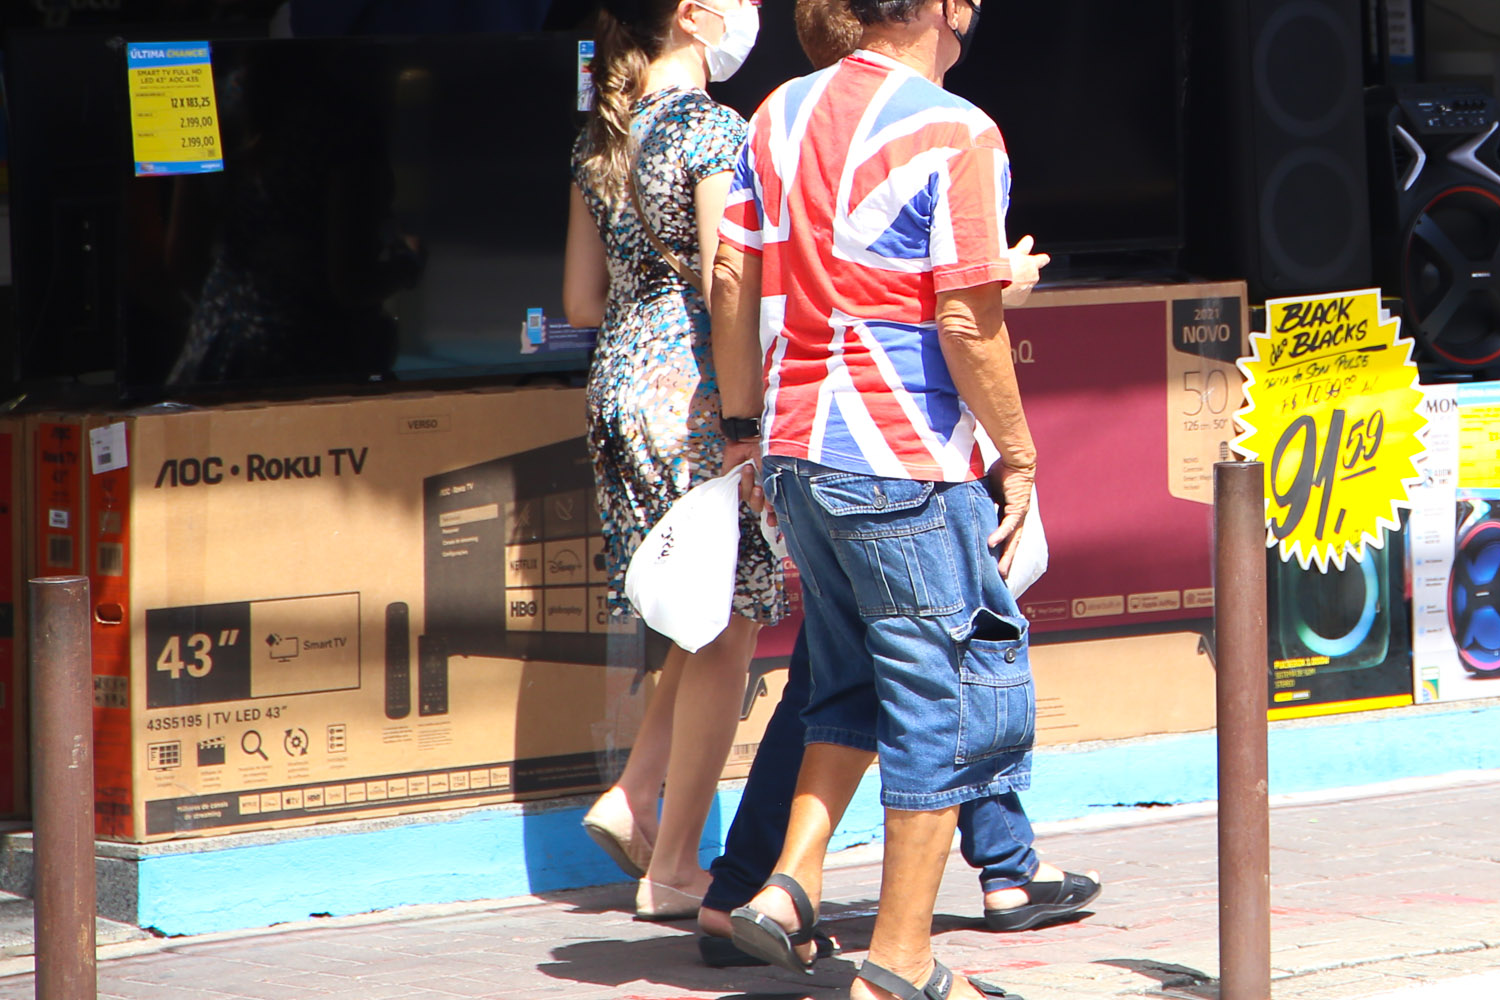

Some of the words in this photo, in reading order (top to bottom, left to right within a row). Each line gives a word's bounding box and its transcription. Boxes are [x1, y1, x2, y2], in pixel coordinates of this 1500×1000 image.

[130, 48, 165, 60] ÚLTIMA
[136, 69, 161, 77] SMART
[172, 68, 190, 76] FULL
[170, 98, 179, 109] 12
[180, 116, 213, 129] 2.199,00
[181, 135, 215, 148] 2.199,00
[1194, 307, 1220, 320] 2021
[1275, 297, 1355, 333] BLACK
[1183, 324, 1231, 345] NOVO
[1288, 319, 1368, 358] BLACKS
[1183, 369, 1229, 416] 50
[407, 420, 439, 431] VERSO
[154, 457, 223, 488] AOC
[247, 454, 321, 482] Roku
[328, 447, 368, 476] TV
[510, 601, 538, 617] HBO
[146, 714, 203, 731] 43S5195
[213, 711, 231, 725] TV
[236, 708, 261, 723] LED
